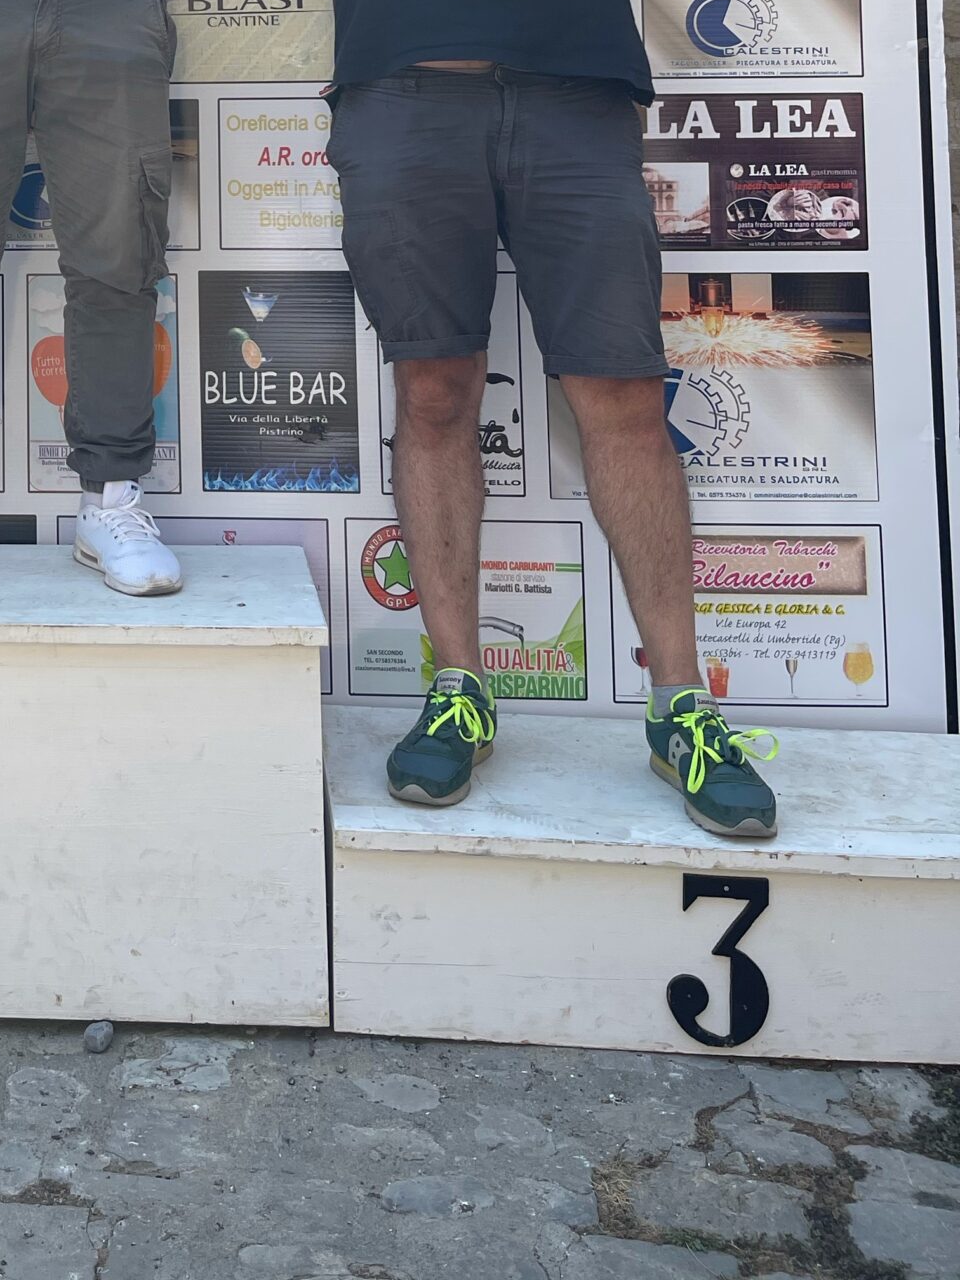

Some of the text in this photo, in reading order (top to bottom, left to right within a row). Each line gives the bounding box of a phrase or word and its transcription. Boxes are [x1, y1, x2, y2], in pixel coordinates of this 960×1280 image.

[207, 15, 280, 28] CANTINE
[724, 46, 829, 56] CALESTRINI
[227, 114, 308, 131] Oreficeria
[642, 99, 856, 139] LA LEA
[258, 146, 295, 166] A.R.
[749, 164, 809, 176] LA LEA
[227, 179, 308, 200] Oggetti in
[259, 210, 343, 230] Bigiotteria
[204, 371, 347, 405] BLUE BAR
[229, 414, 328, 423] Via della Libertà
[259, 427, 304, 436] Pistrino
[483, 460, 522, 470] bblicità
[688, 475, 840, 484] PIEGATURA SALDATURA
[364, 535, 383, 564] MONDO
[692, 540, 838, 557] Ricevitoria Tabacchi
[481, 561, 555, 571] MONDO CARBURANTI
[485, 583, 552, 594] Mariotti G. Battista
[716, 603, 845, 615] GESSICA E GLORIA & C.
[736, 620, 772, 632] Europa
[775, 620, 787, 628] 42
[696, 633, 846, 649] ntecastelli di Umbertide (Pg)
[666, 872, 770, 1049] 3
